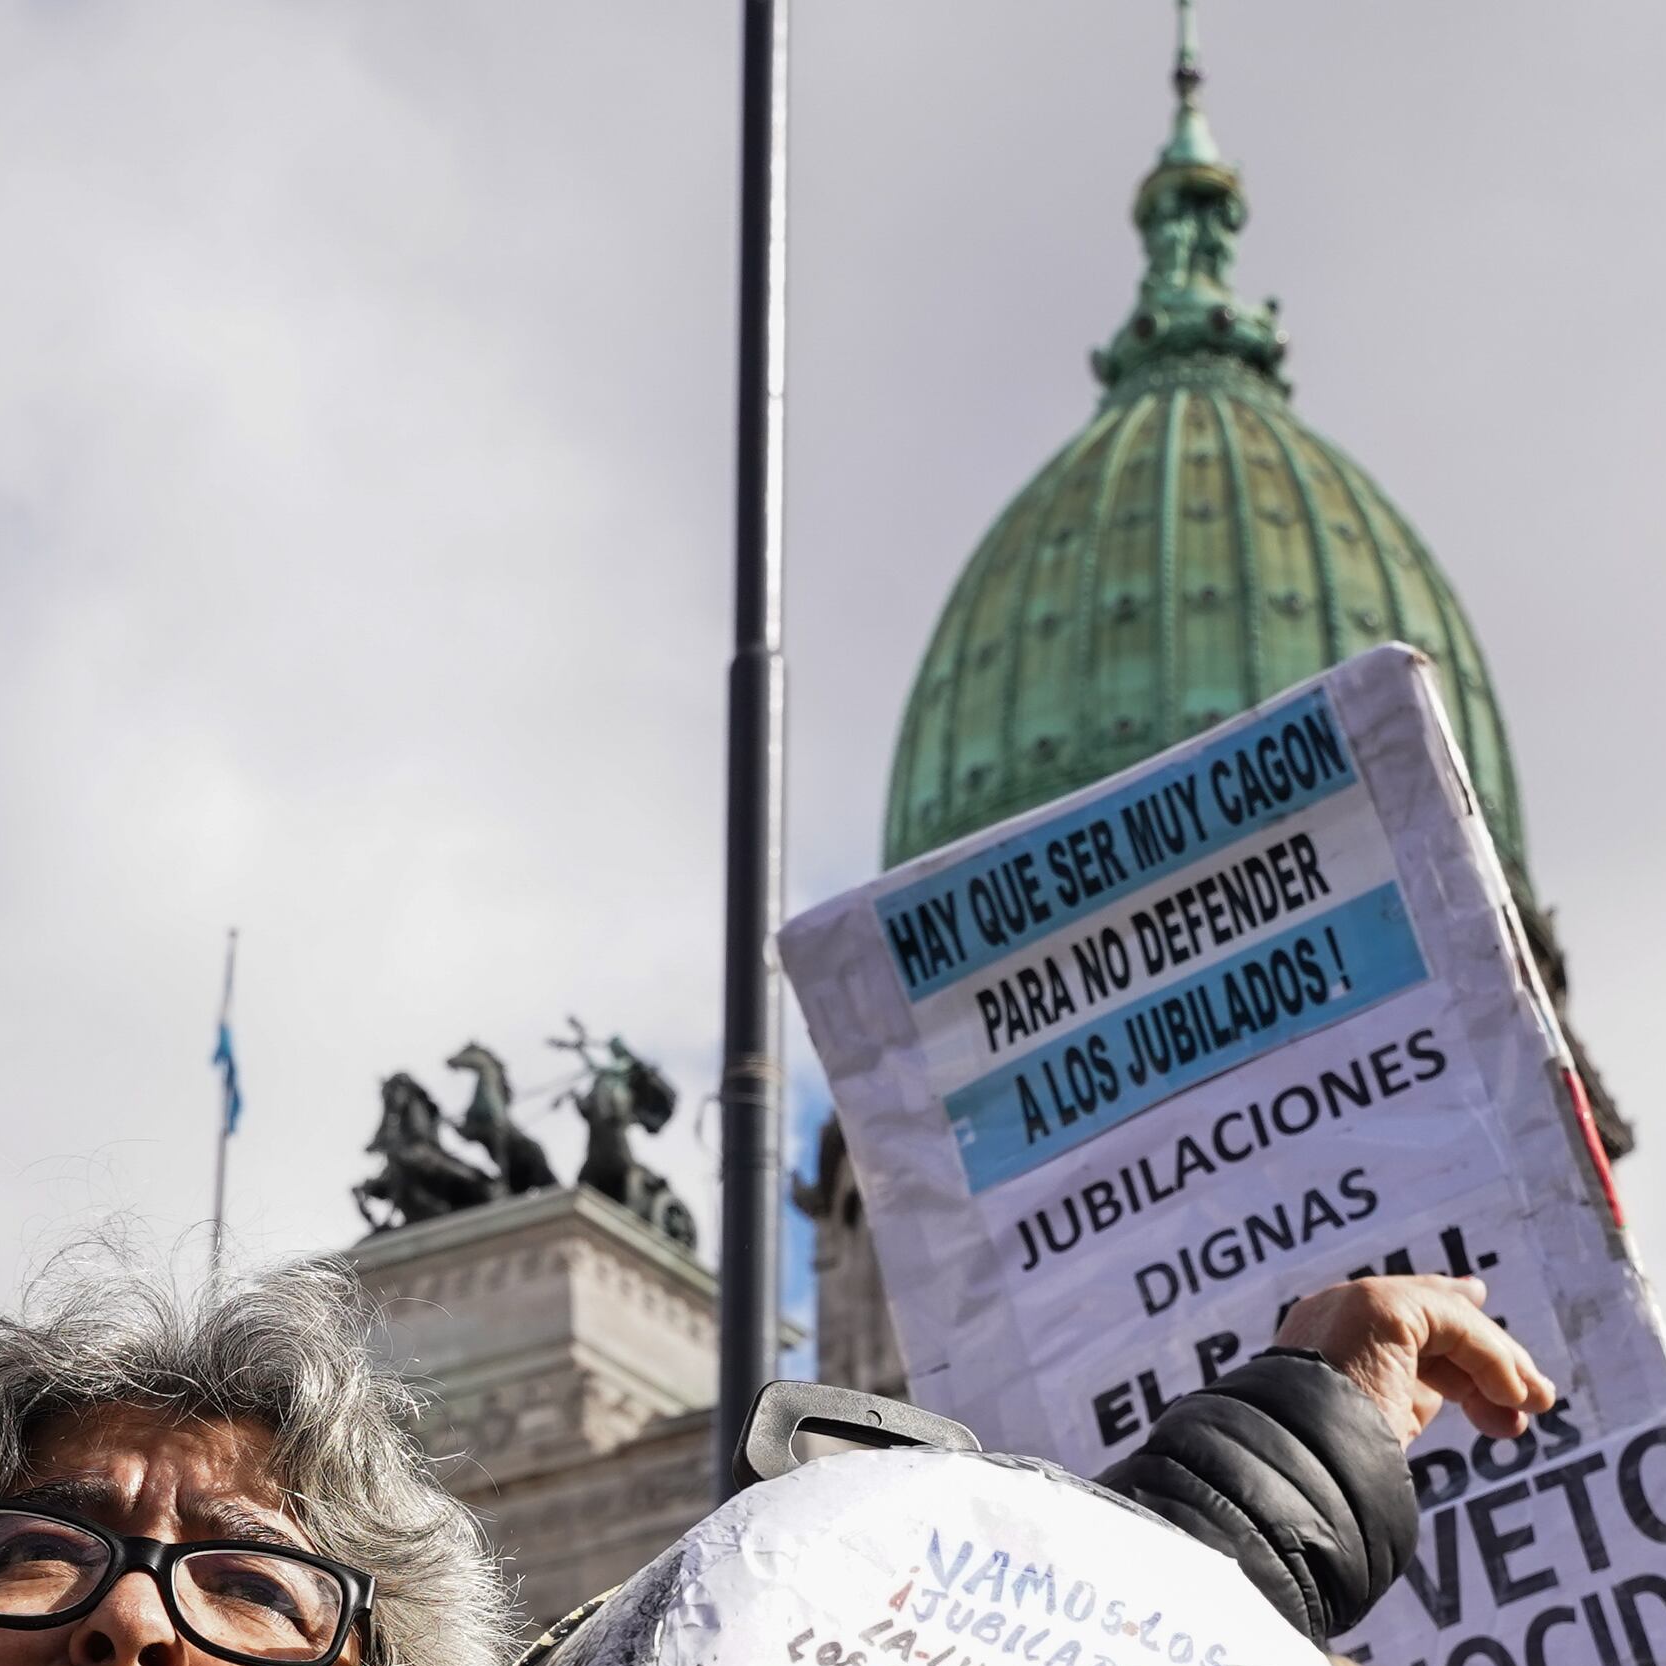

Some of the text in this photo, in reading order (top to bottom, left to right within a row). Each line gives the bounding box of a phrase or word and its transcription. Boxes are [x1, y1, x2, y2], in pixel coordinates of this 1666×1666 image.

[888, 706, 1347, 989] HAY QUE SER MUY CAGON
[975, 831, 1330, 1054] PARA NO DEFENDER
[1015, 1074, 1050, 1145] A
[1042, 1034, 1120, 1127] LOS
[1016, 1027, 1448, 1273] JUBILACIONES
[1135, 1167, 1379, 1317] DIGNAS
[1093, 1368, 1182, 1447] EL
[1415, 1394, 1582, 1507] DOS
